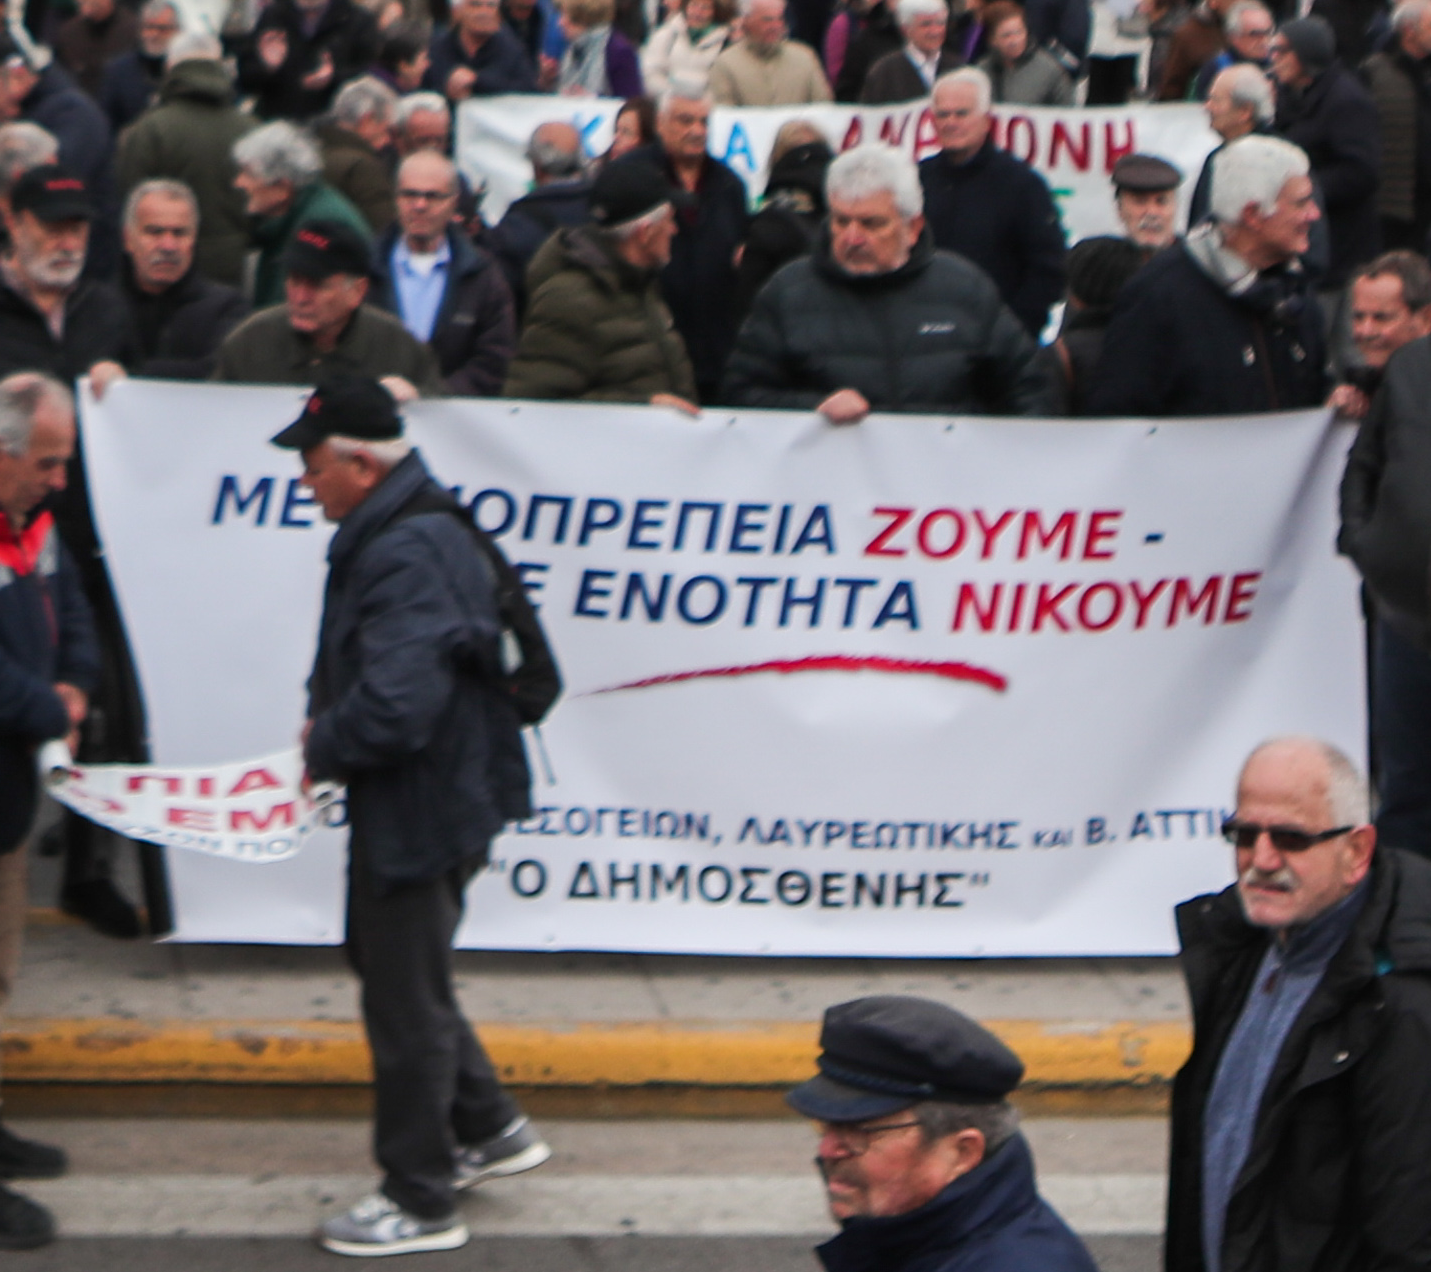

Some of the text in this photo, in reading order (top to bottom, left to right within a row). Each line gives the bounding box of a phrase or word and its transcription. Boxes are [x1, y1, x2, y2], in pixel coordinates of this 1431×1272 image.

[451, 485, 836, 557] ΟΠΡΕΠΕΙΑ
[863, 506, 1125, 562] ΖΟΥΜΕ
[572, 568, 921, 632] ΕΝΟΤΗΤΑ
[950, 570, 1264, 634] ΝΙΚΟΥΜΕ
[503, 807, 723, 845] ΕΣΟΓΕΙΩΝ,
[738, 817, 1022, 850] ΛΑΥΡΕΩΤΙΚΗΣ
